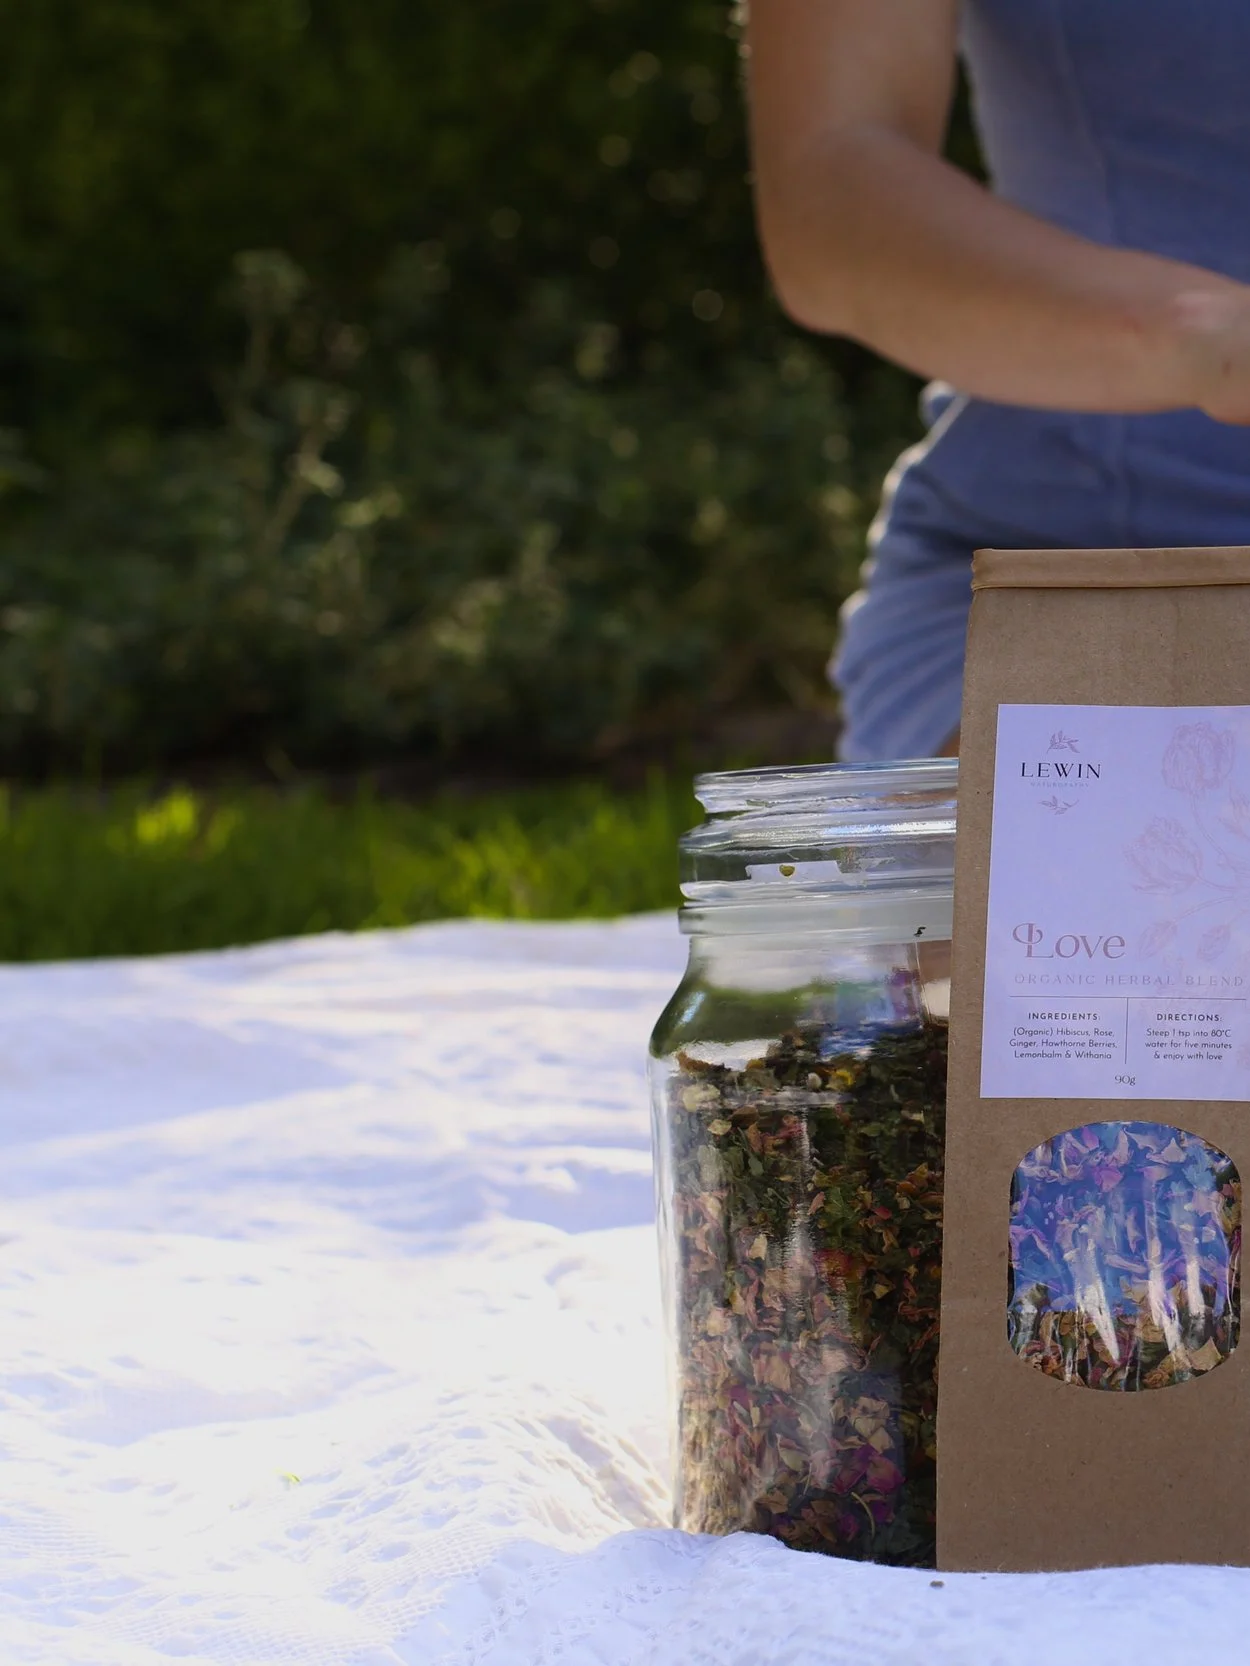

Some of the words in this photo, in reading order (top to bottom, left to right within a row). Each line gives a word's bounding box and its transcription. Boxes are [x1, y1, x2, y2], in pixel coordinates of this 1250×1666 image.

[1021, 762, 1101, 779] LEWIN
[1012, 922, 1126, 960] Love
[1014, 973, 1096, 985] ORGANIC
[1105, 974, 1175, 986] HERBAL
[1186, 975, 1244, 987] BLEND
[1013, 1027, 1053, 1037] (Organic)
[1056, 1027, 1091, 1037] Hibiscus,
[1094, 1028, 1115, 1037] Rose,
[1146, 1028, 1169, 1038] Steep
[1178, 1029, 1191, 1038] tsp
[1193, 1029, 1209, 1037] into
[1009, 1039, 1038, 1048] Ginger,
[1041, 1039, 1086, 1047] Hawthorne
[1089, 1039, 1118, 1048] Berries,
[1170, 1040, 1181, 1048] for
[1184, 1040, 1199, 1048] five
[1201, 1041, 1232, 1049] minutes
[1014, 1050, 1062, 1059] Lemonbalm
[1065, 1050, 1072, 1059] &
[1075, 1050, 1112, 1059] Withania
[1153, 1051, 1160, 1060] &
[1163, 1052, 1184, 1061] enjoy
[1187, 1052, 1204, 1060] with
[1206, 1052, 1223, 1060] love
[1114, 1075, 1136, 1086] 90g
